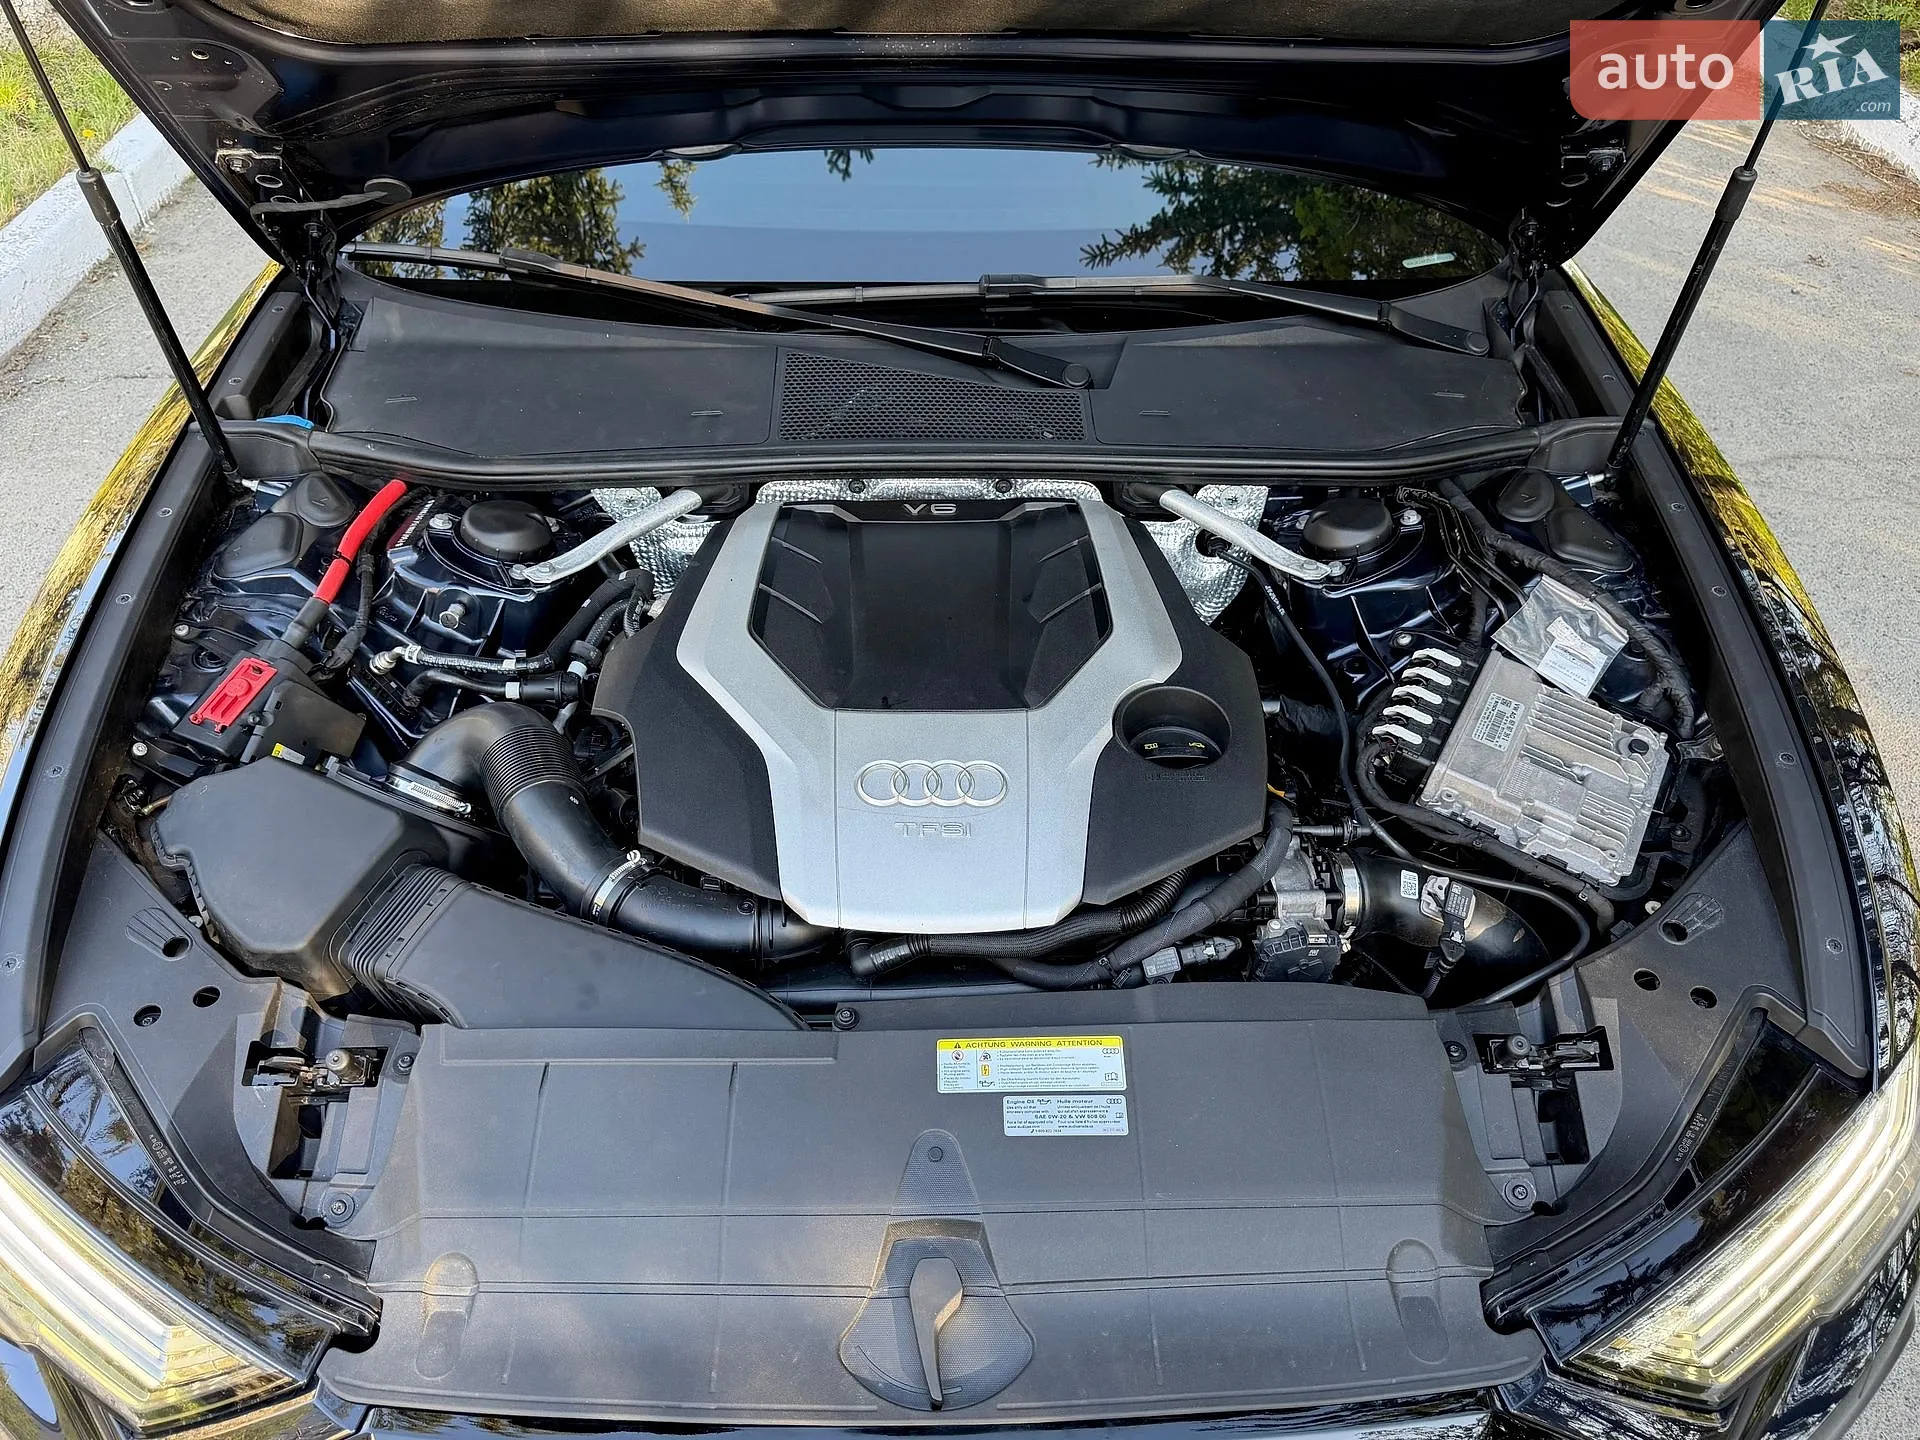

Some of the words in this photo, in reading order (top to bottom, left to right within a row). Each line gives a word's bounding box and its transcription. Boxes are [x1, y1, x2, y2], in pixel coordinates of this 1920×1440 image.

[903, 503, 957, 515] V6
[895, 821, 972, 838] TFSI
[965, 1041, 1006, 1049] ACHTUNG
[1010, 1040, 1052, 1048] WARNING
[1056, 1039, 1103, 1047] ATTENTION
